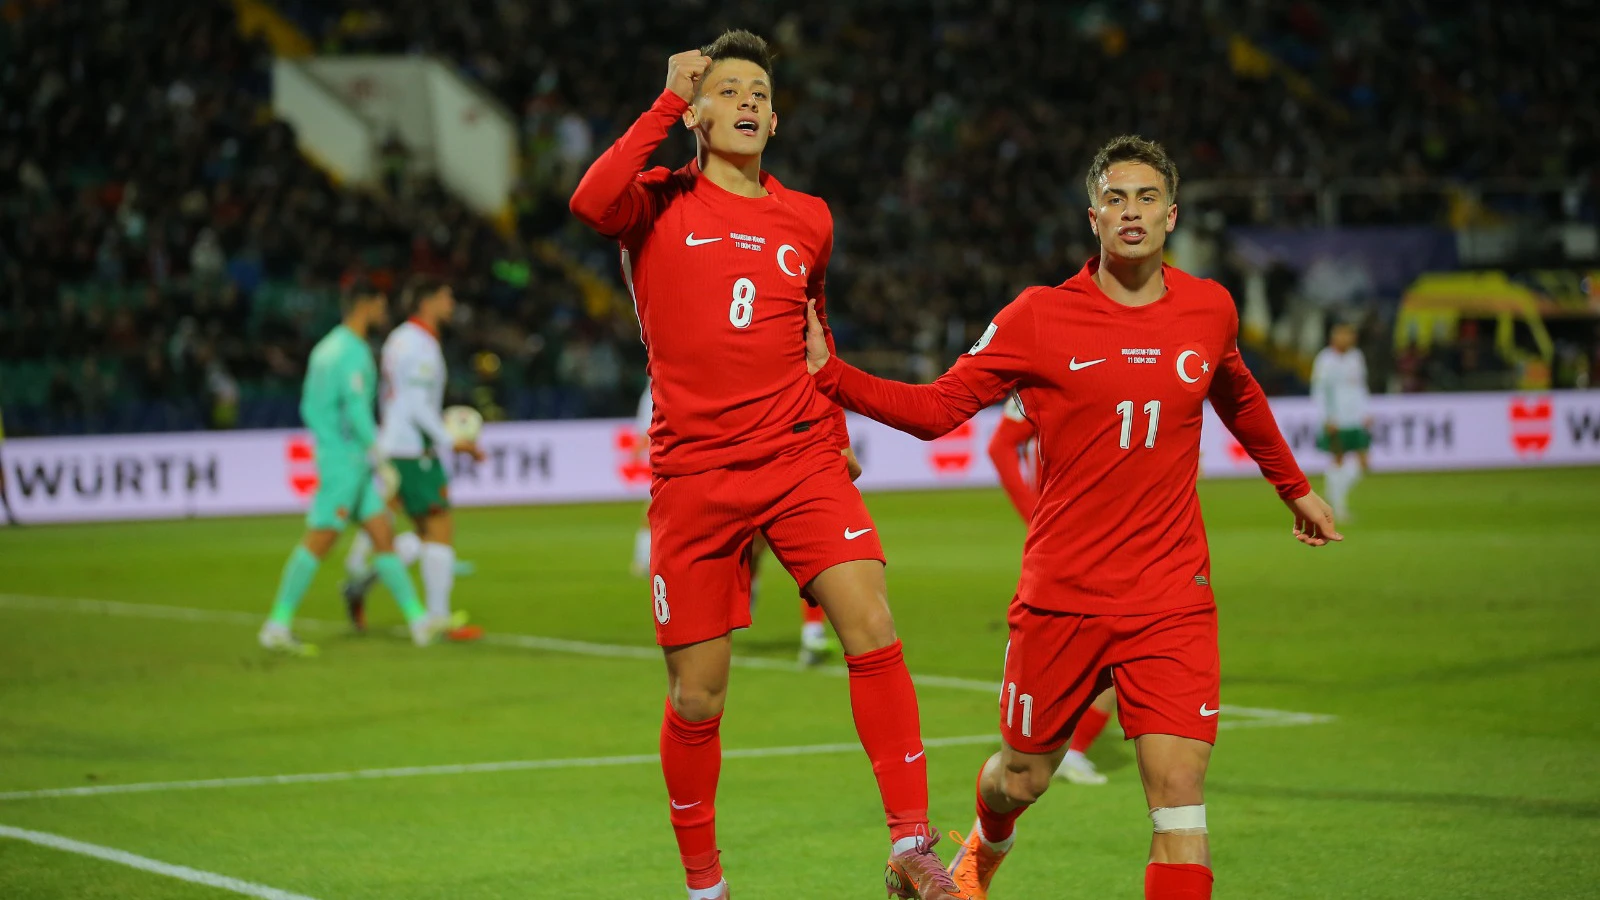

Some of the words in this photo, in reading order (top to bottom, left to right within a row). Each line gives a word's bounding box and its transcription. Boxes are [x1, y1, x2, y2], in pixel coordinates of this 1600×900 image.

[729, 277, 756, 329] 8
[1116, 400, 1161, 449] 11
[653, 574, 670, 625] 8
[1007, 682, 1033, 737] 11
